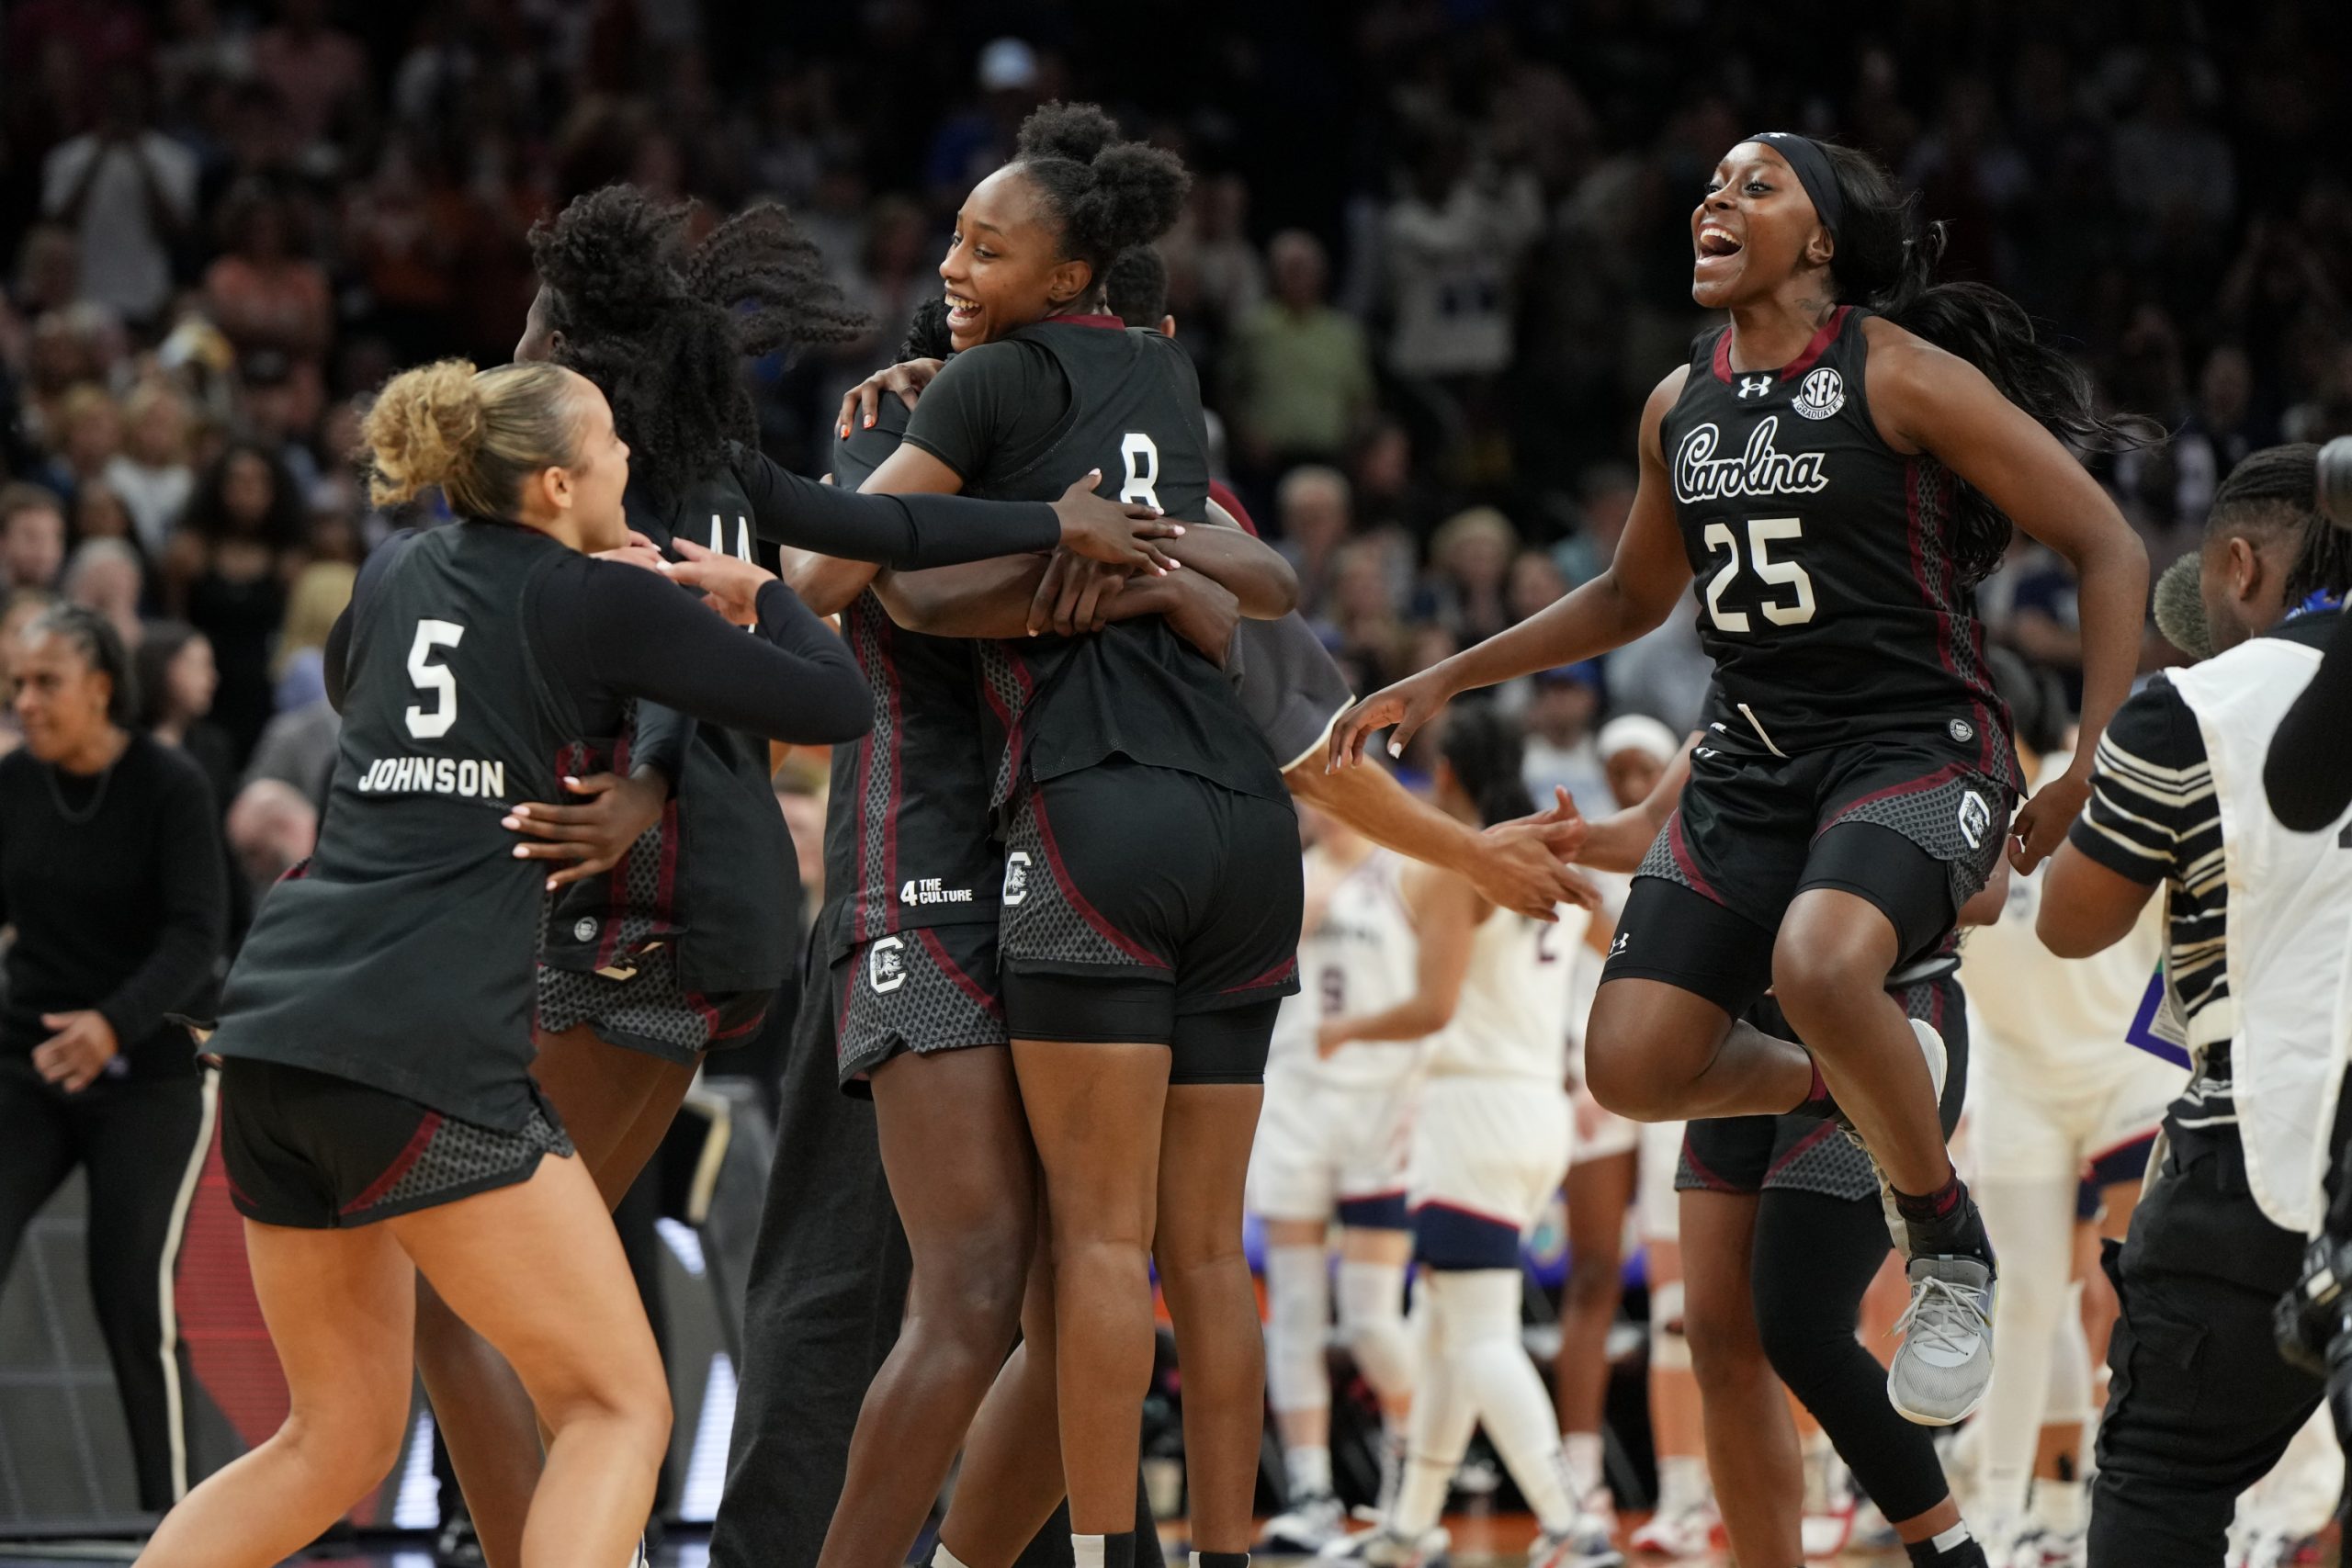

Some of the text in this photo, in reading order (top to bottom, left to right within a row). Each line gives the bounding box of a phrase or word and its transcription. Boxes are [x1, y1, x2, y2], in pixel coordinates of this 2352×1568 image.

[1796, 402, 1840, 419] GRADUATE
[1804, 371, 1839, 407] SEC
[1120, 434, 1161, 509] 8
[1675, 416, 1829, 503] Carolina
[1704, 518, 1816, 633] 25
[405, 619, 465, 739] 5
[358, 757, 504, 798] JOHNSON
[900, 878, 942, 907] 4 THE
[919, 889, 973, 904] CULTURE
[870, 936, 908, 994] C
